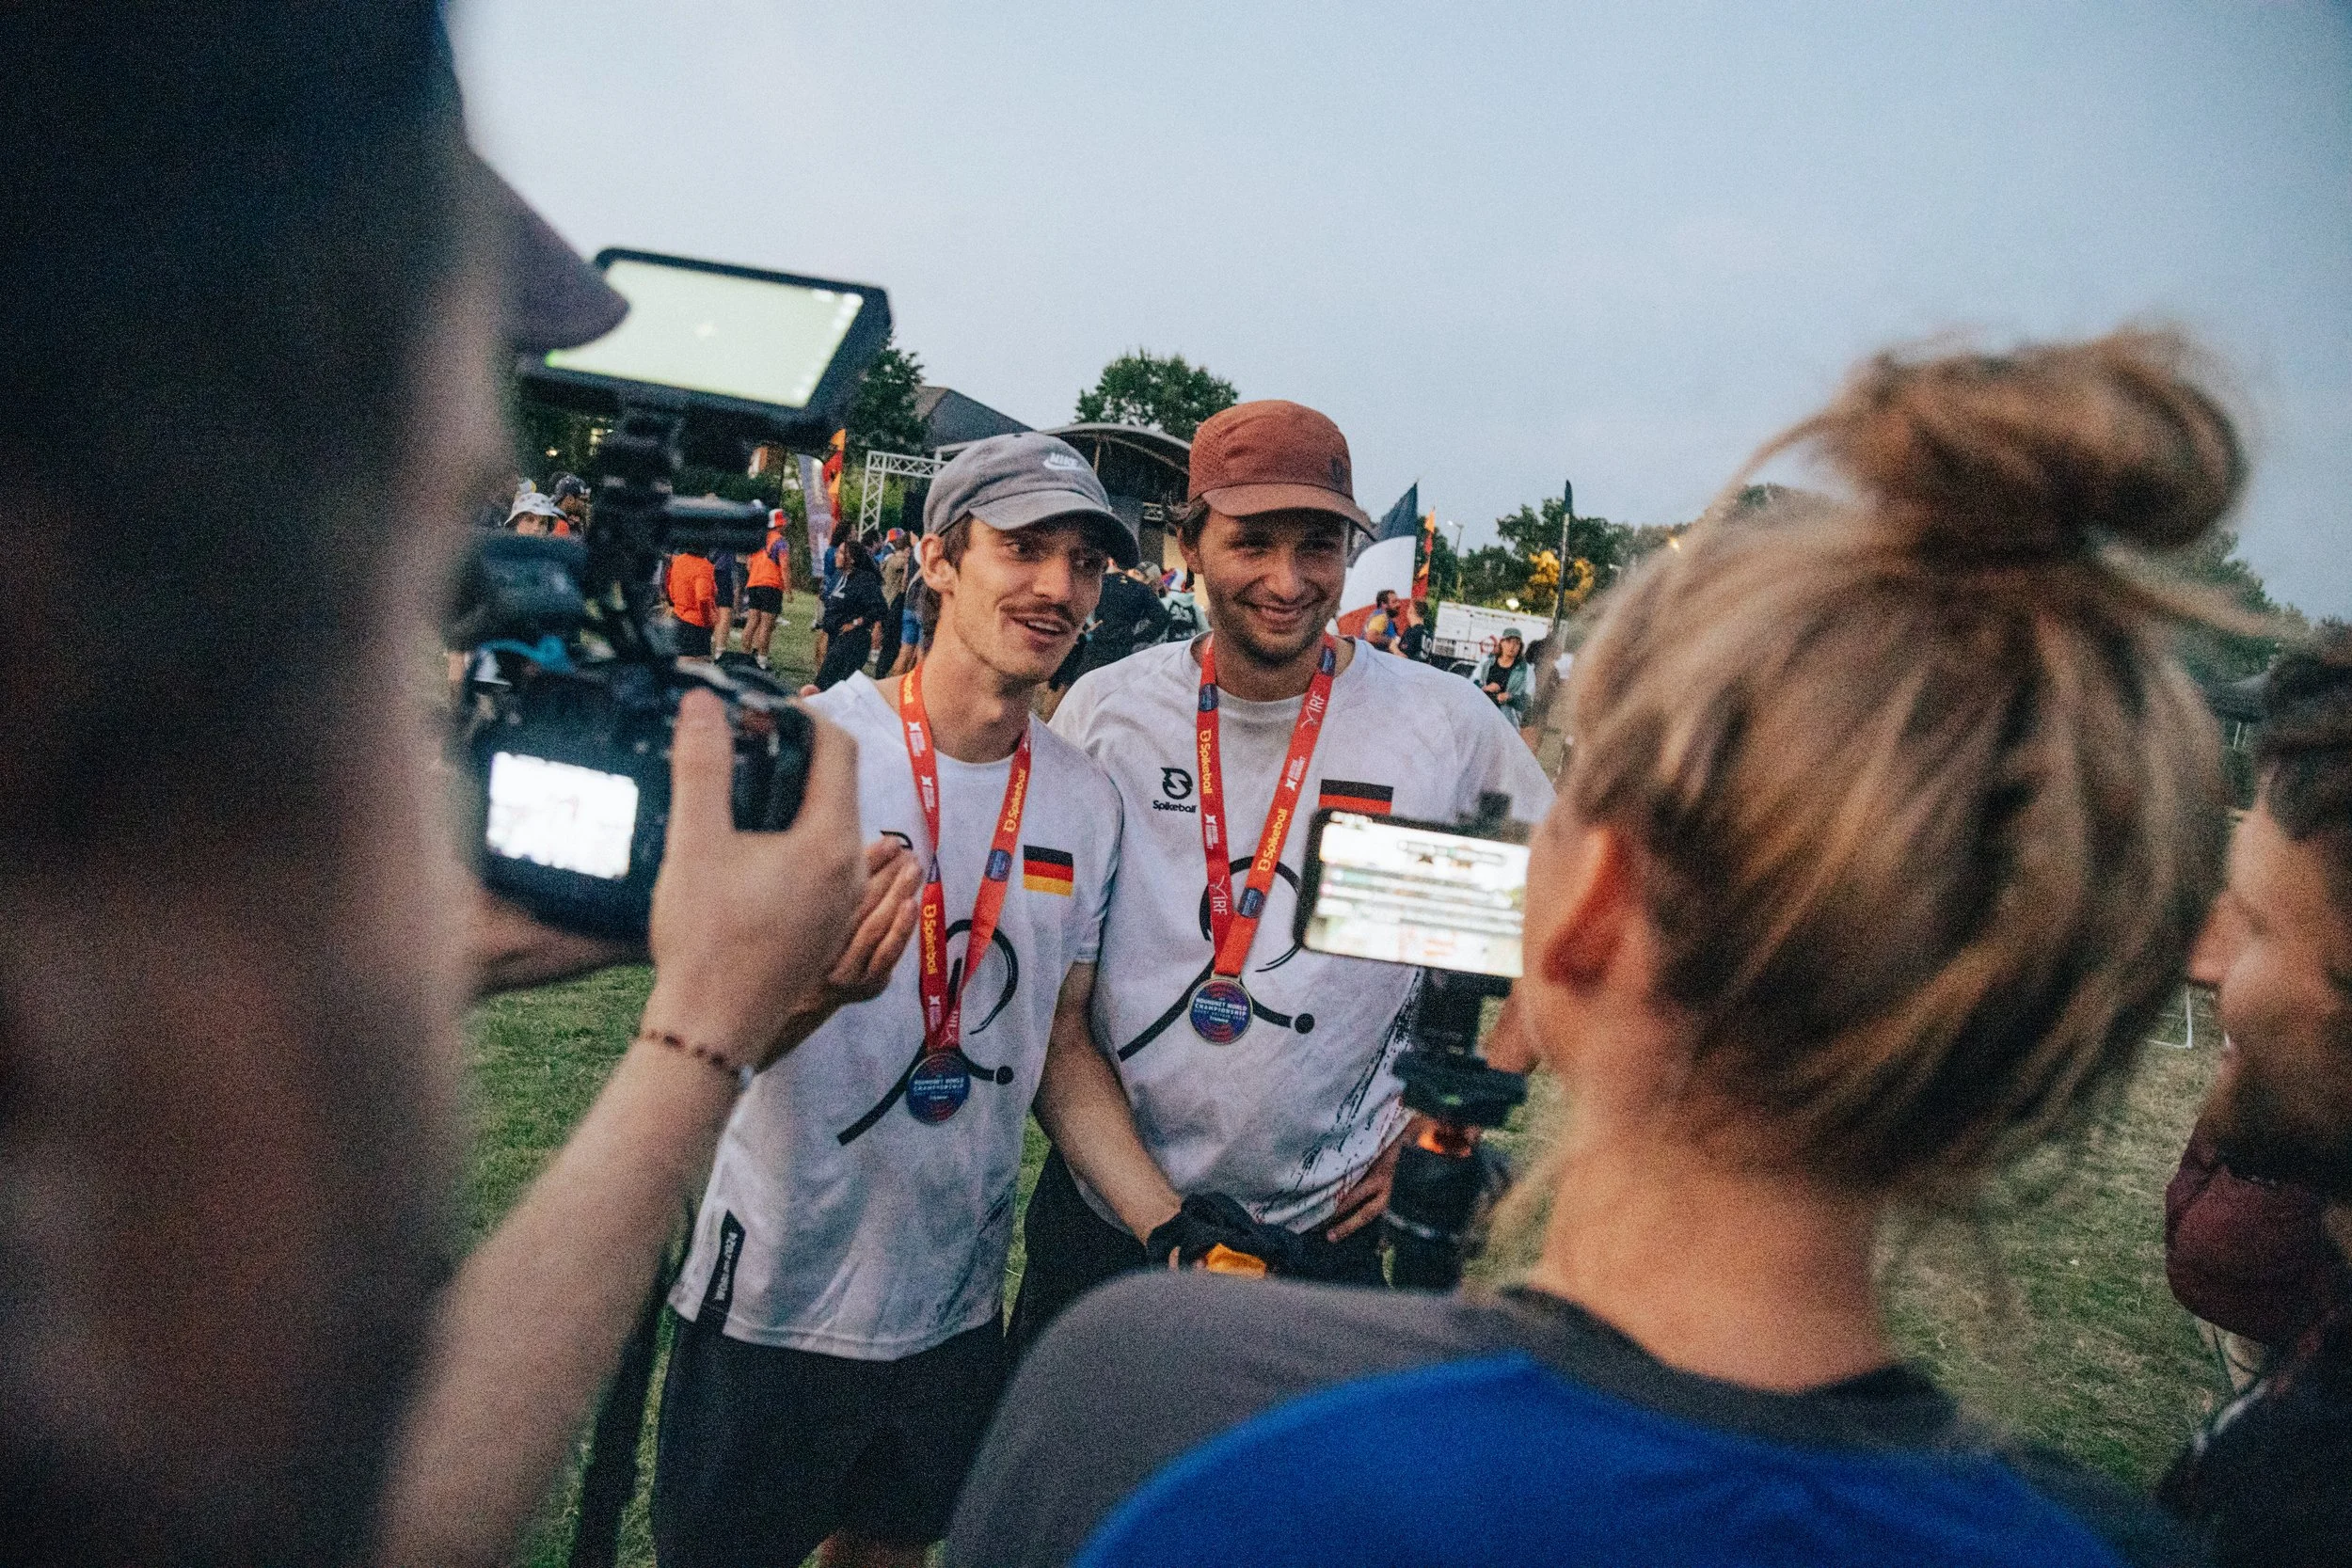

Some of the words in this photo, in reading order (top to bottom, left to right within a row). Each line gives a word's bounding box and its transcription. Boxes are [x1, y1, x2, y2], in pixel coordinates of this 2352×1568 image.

[1008, 767, 1026, 820] Spikeball
[1200, 743, 1213, 794] Spikeball
[1152, 800, 1198, 814] Spikeball
[1263, 808, 1288, 860] Spikeball
[924, 919, 938, 974] Spikeball
[1194, 1003, 1247, 1017] CHAMPIONSHIP
